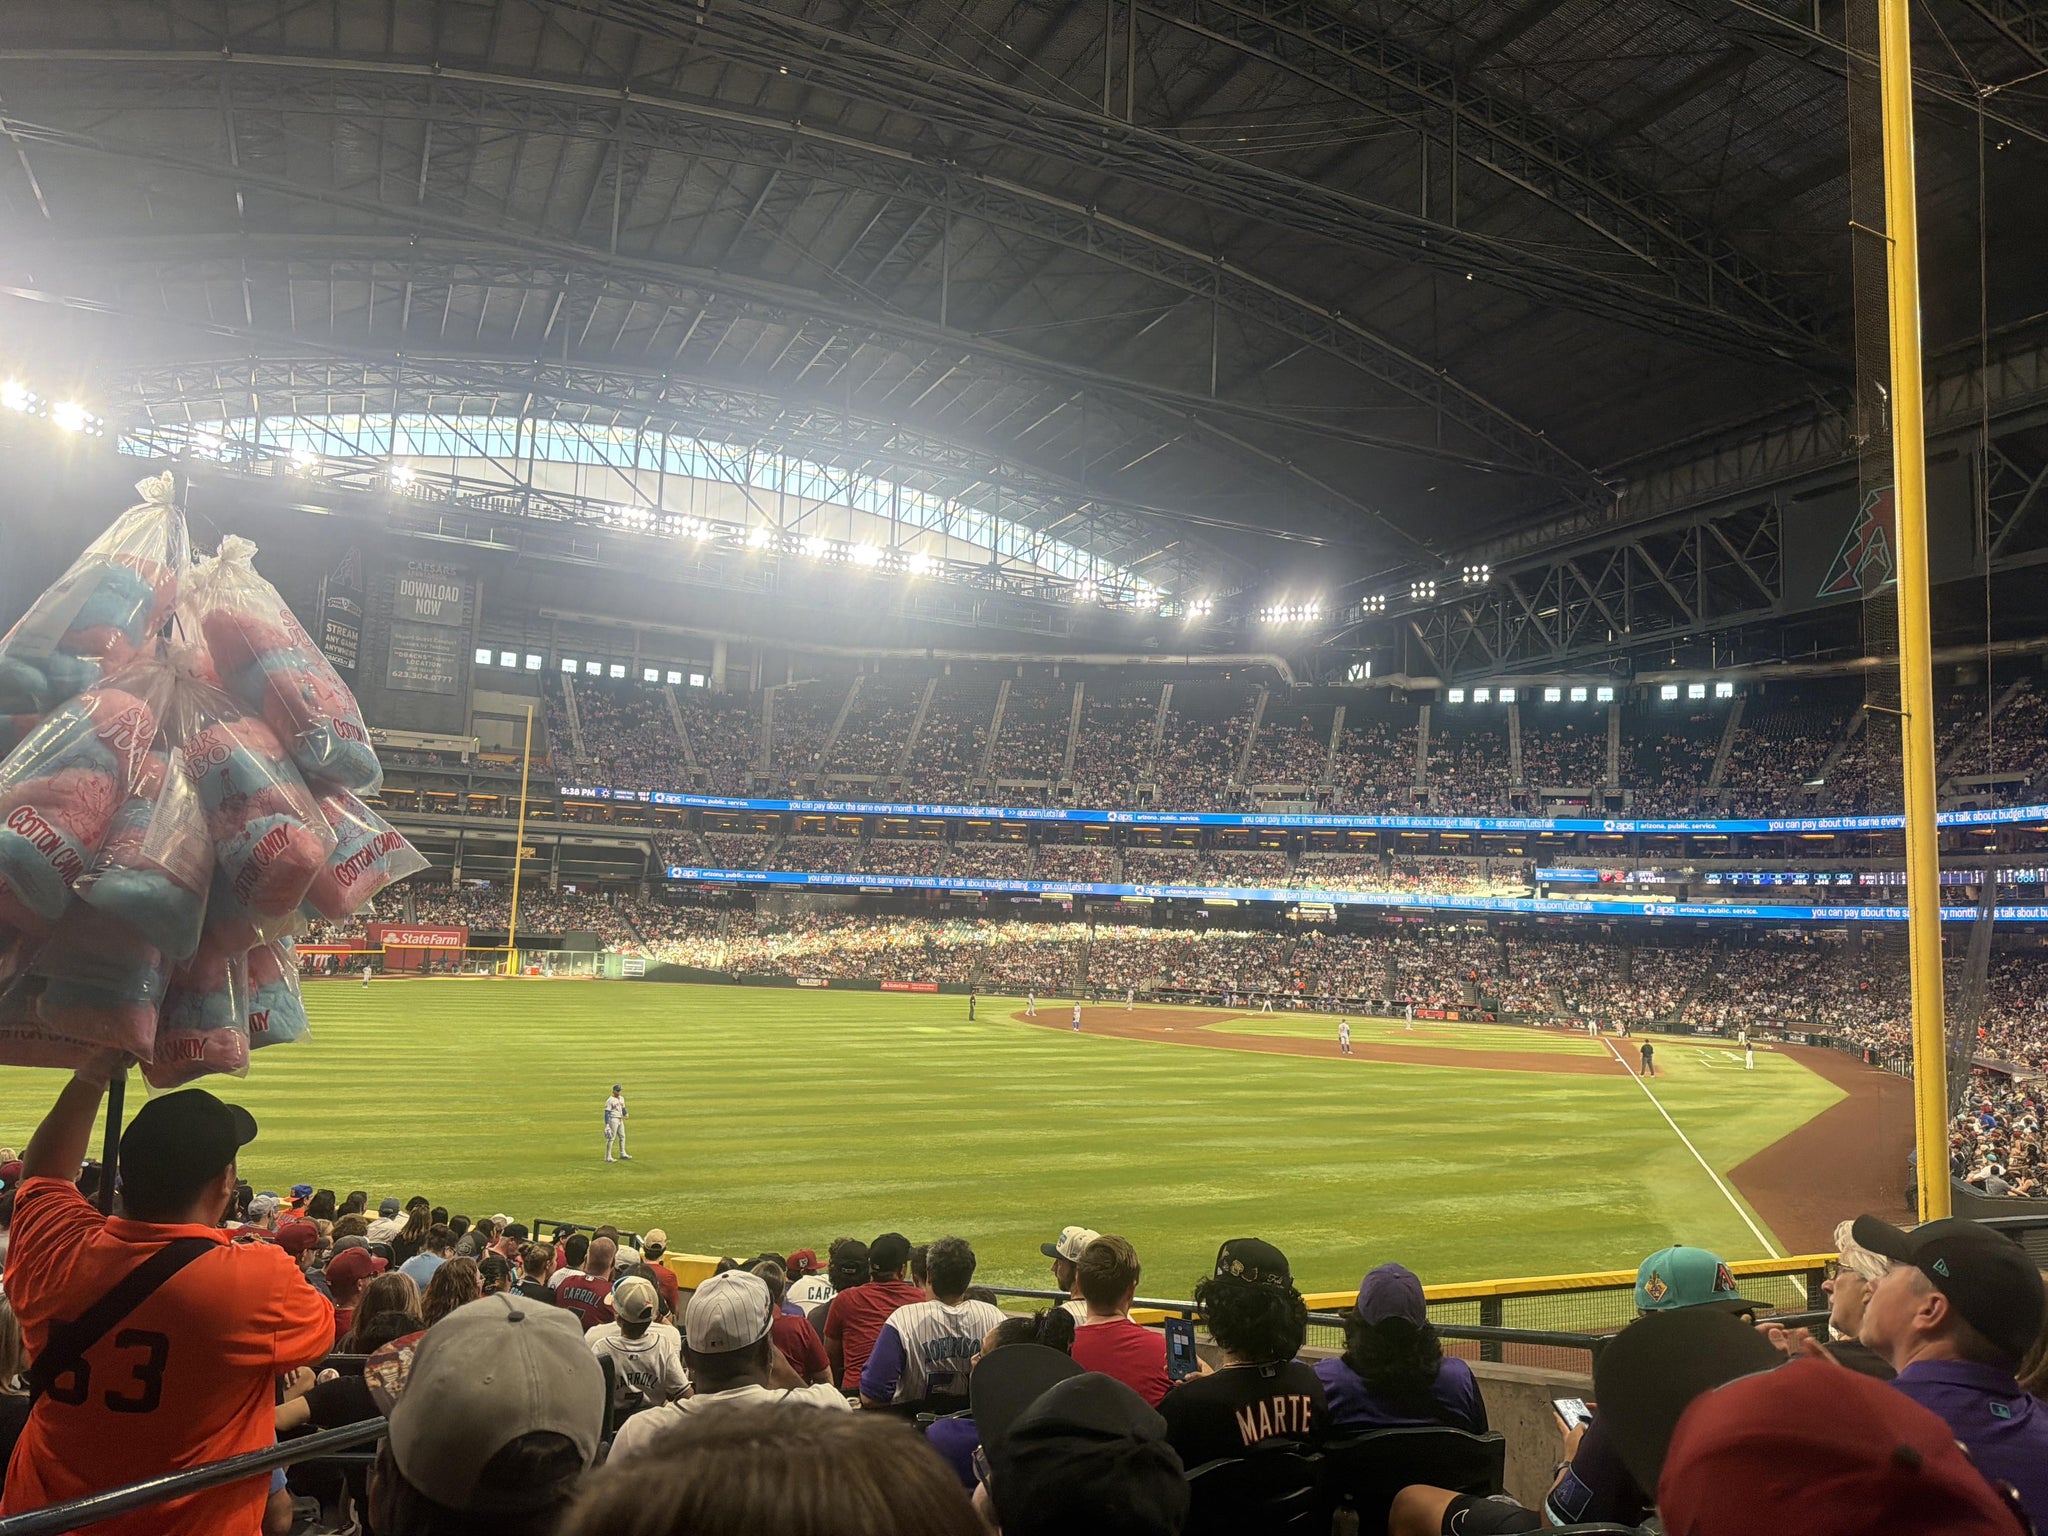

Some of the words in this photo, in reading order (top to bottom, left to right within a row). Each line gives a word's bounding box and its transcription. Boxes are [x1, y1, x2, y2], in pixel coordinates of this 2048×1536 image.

[408, 561, 456, 576] CAESARS
[400, 580, 460, 602] DOWNLOAD
[416, 598, 441, 616] NOW
[326, 622, 358, 640] STREAM
[326, 634, 340, 644] ANY
[341, 638, 358, 650] GAME
[325, 643, 357, 659] ANYWHERE
[406, 659, 441, 668] LOCATION
[392, 671, 454, 682] 623.304.0777
[581, 788, 596, 797] PM
[666, 794, 681, 804] aps
[790, 801, 800, 810] you
[874, 805, 892, 813] every
[963, 807, 985, 815] budget
[986, 808, 1005, 817] billing.
[1017, 809, 1068, 819] aps.com/LetsTalk
[1937, 812, 1953, 823] let's
[1955, 812, 1971, 821] talk
[1973, 810, 1997, 821] about
[1999, 808, 2025, 820] budget
[1118, 814, 1133, 822] aps
[1396, 817, 1410, 825] talk
[1411, 818, 1431, 826] about
[1433, 818, 1457, 827] budget
[1460, 818, 1482, 829] billing.
[1496, 820, 1555, 829] aps.com/LetsTalk
[1770, 821, 1784, 831] you
[1801, 821, 1816, 830] pay
[1818, 819, 1840, 828] about
[1842, 818, 1856, 827] the
[1881, 817, 1905, 828] every
[8, 804, 66, 858] COTTON
[1616, 822, 1635, 830] aps
[252, 822, 290, 867] CANDY
[334, 844, 374, 888] COTTON
[373, 831, 405, 859] CANDY
[682, 870, 698, 878] aps
[808, 874, 820, 883] you
[833, 876, 845, 884] pay
[846, 875, 864, 883] about
[895, 878, 913, 886] every
[939, 878, 953, 886] let's
[953, 879, 965, 887] talk
[986, 880, 1009, 890] budget
[1010, 881, 1030, 891] billing.
[1042, 883, 1093, 892] aps.com/LetsTalk
[1145, 886, 1161, 895] aps
[1434, 896, 1448, 904] talk
[1451, 897, 1470, 905] about
[1472, 897, 1495, 908] budget
[1534, 900, 1593, 912] aps.com/LetsTalk
[1656, 906, 1675, 914] aps
[1812, 909, 1827, 918] you
[1844, 909, 1858, 918] pay
[1860, 907, 1884, 917] about
[1886, 907, 1900, 917] the
[2001, 908, 2015, 918] talk
[2017, 908, 2039, 918] about
[563, 1286, 602, 1308] CARROLL
[1235, 1394, 1312, 1446] MARTE
